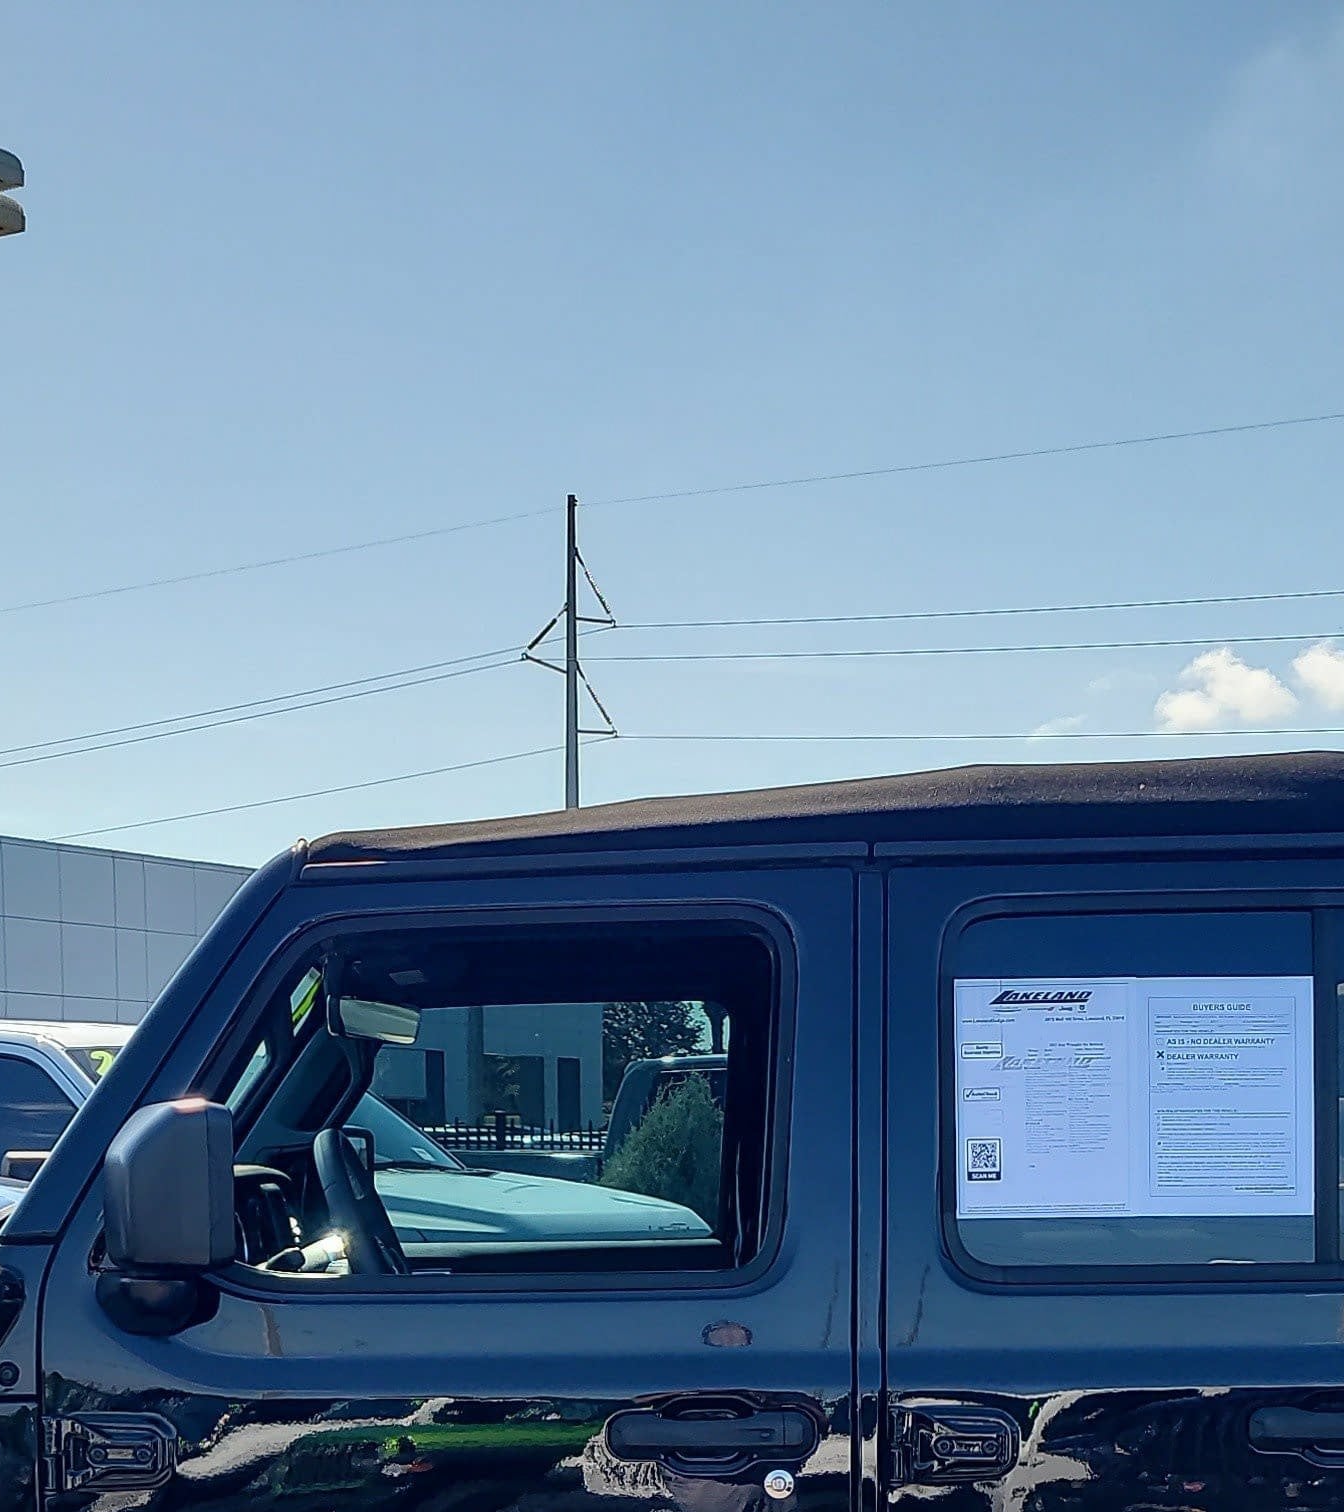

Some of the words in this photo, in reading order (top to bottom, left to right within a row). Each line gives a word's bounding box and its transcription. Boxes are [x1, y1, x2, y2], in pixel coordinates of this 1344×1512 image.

[989, 989, 1093, 1005] LAKELAND
[1192, 1003, 1225, 1011] BUYERS
[1226, 1003, 1252, 1011] GUIDE
